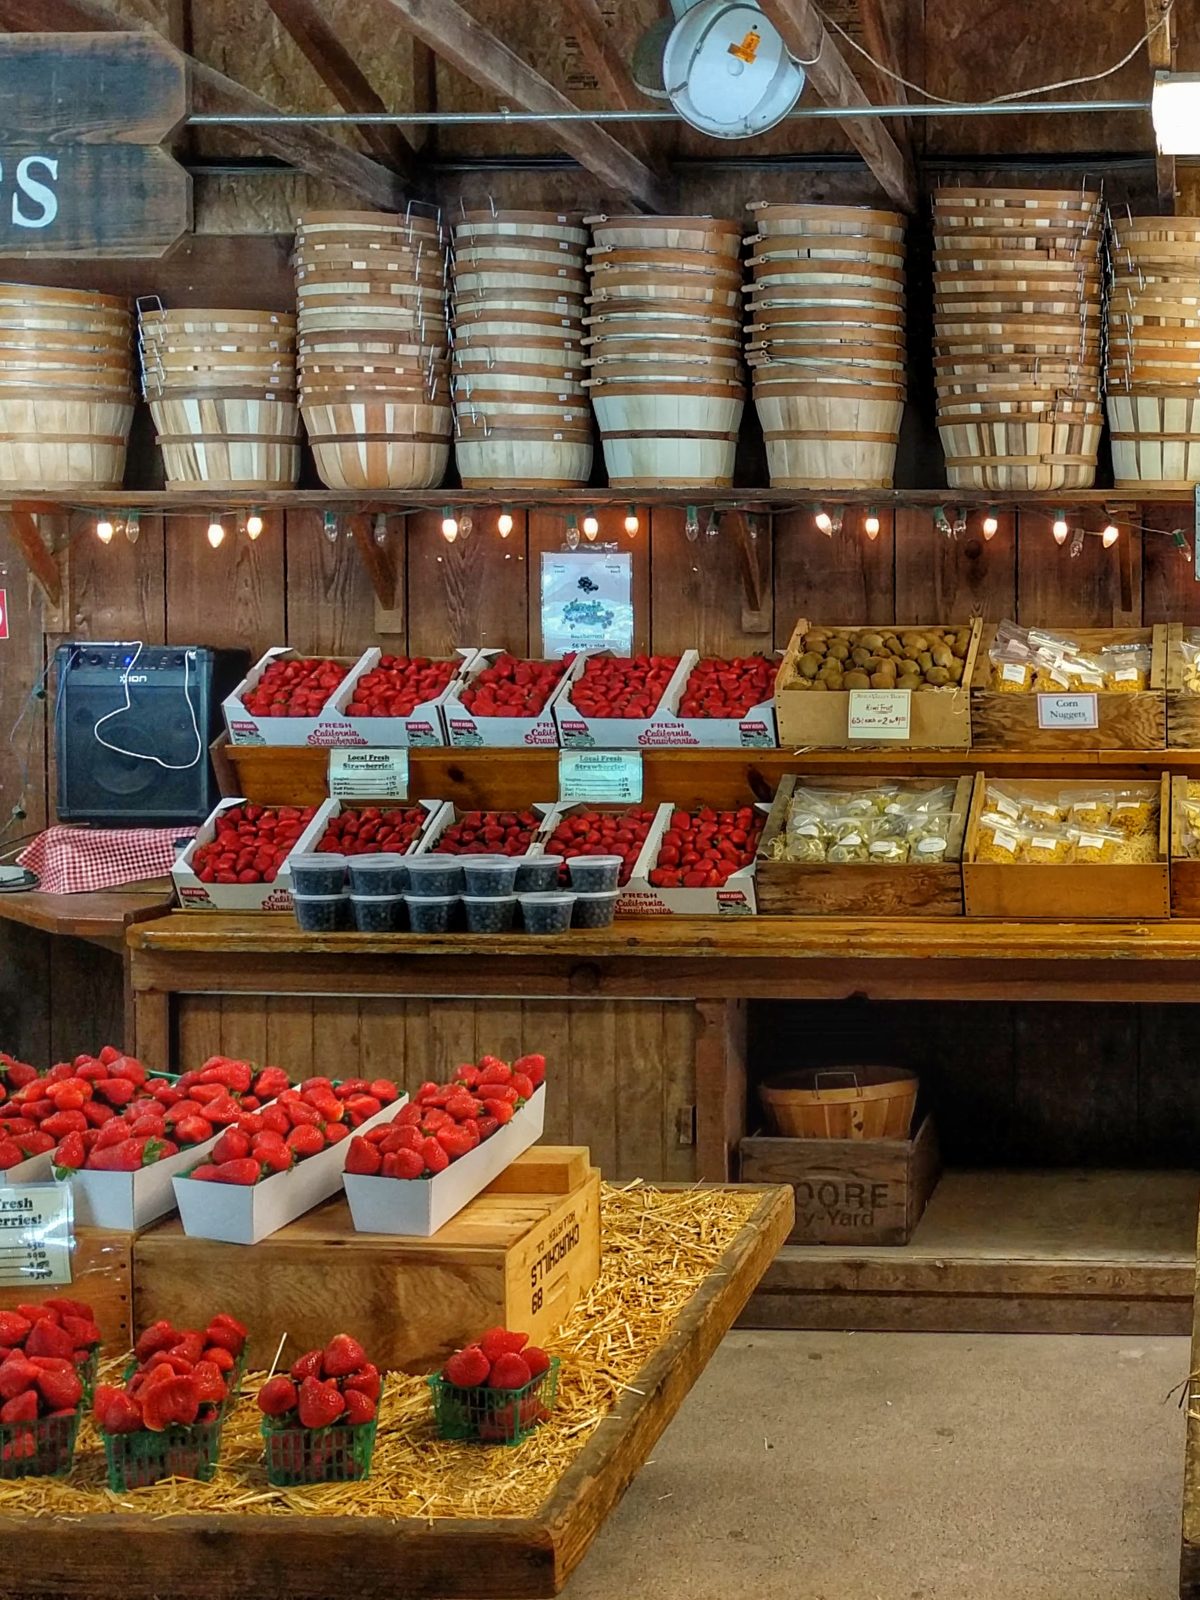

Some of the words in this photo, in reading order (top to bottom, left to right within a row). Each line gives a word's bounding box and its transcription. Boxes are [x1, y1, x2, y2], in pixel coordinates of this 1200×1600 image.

[1056, 699, 1079, 707] Corn
[1050, 710, 1086, 720] Nuggets
[0, 1197, 33, 1209] resh
